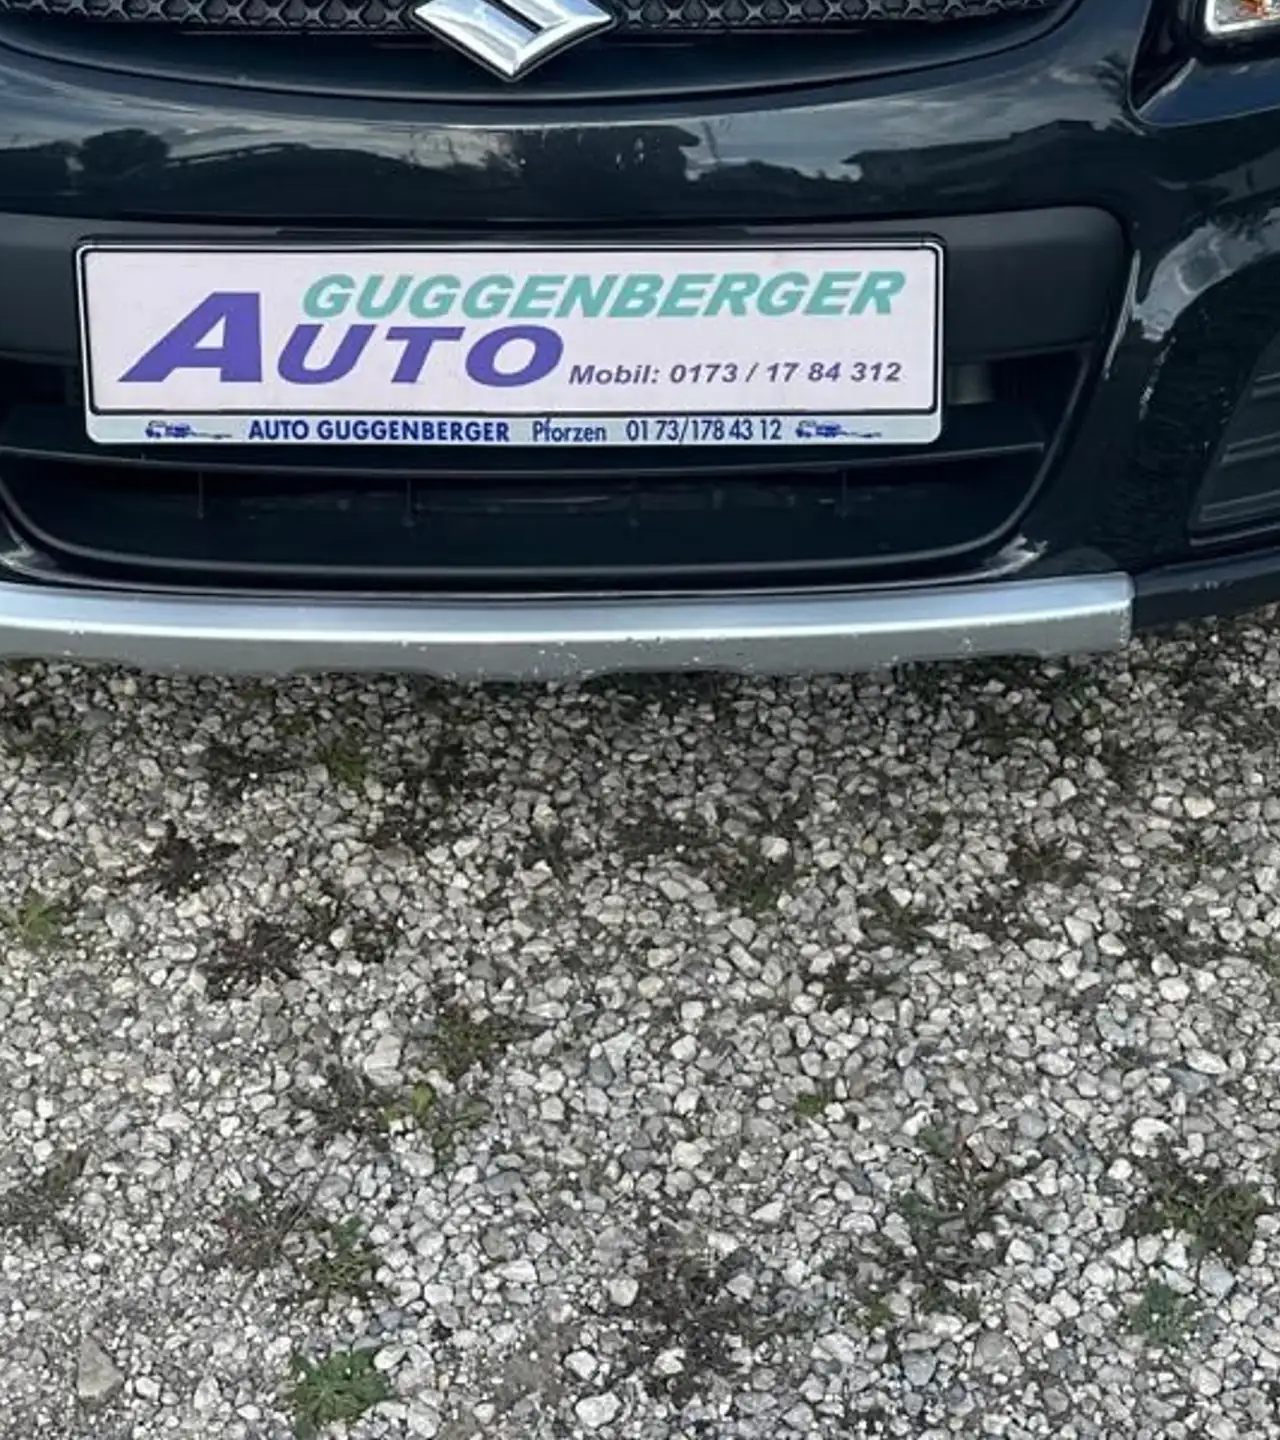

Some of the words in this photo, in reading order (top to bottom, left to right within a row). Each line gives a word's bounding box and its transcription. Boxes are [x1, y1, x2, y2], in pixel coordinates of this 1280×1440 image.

[303, 271, 905, 318] GUGGENBERGER
[118, 292, 564, 387] AUTO
[569, 363, 659, 385] Mobil:
[671, 363, 738, 384] 0173
[745, 363, 758, 384] /
[768, 363, 798, 383] 17
[808, 362, 841, 383] 84
[851, 362, 902, 383] 312
[248, 420, 309, 441] AUTO
[317, 419, 509, 442] GUGGENBERGER
[532, 417, 606, 442] Pforzen
